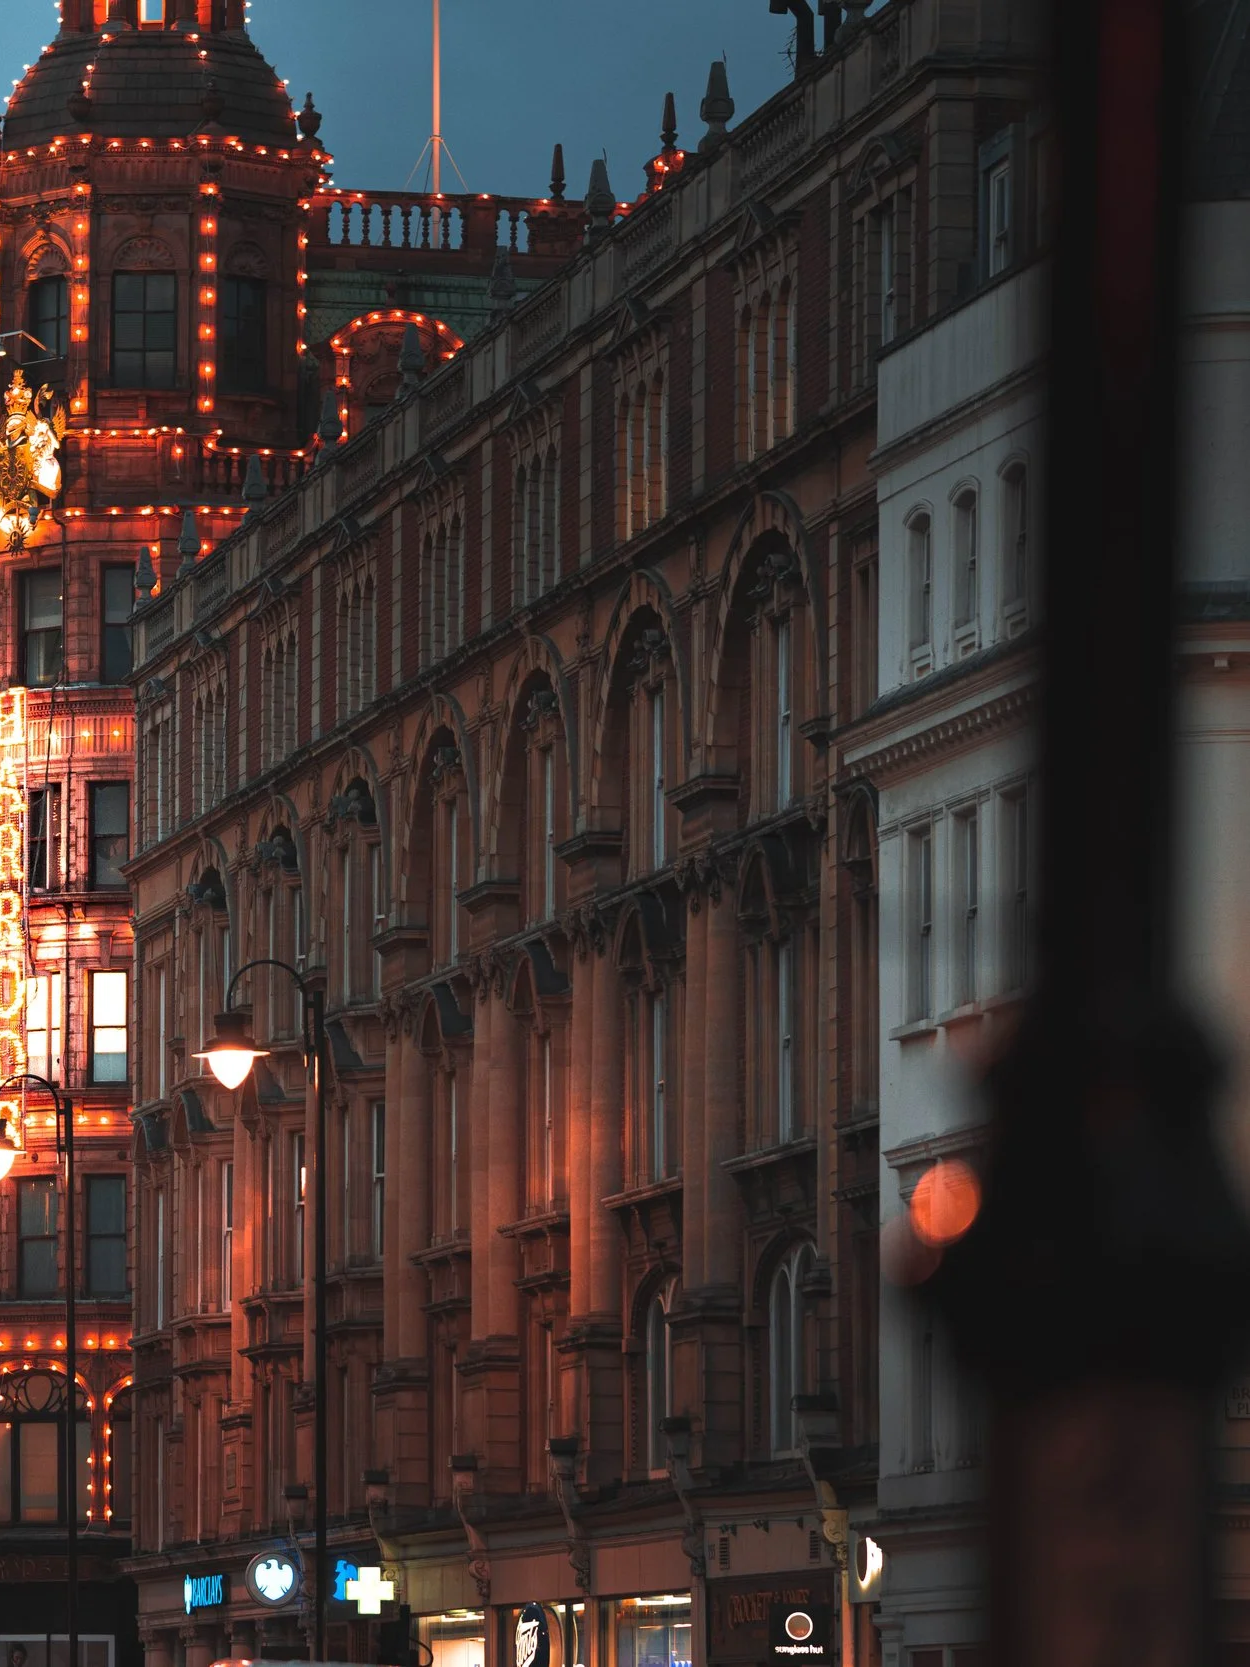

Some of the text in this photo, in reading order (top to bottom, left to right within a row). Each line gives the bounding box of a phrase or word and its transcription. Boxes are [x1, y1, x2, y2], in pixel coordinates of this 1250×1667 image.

[192, 1575, 223, 1607] BARCLAYS
[775, 1645, 823, 1655] sunglass hut
